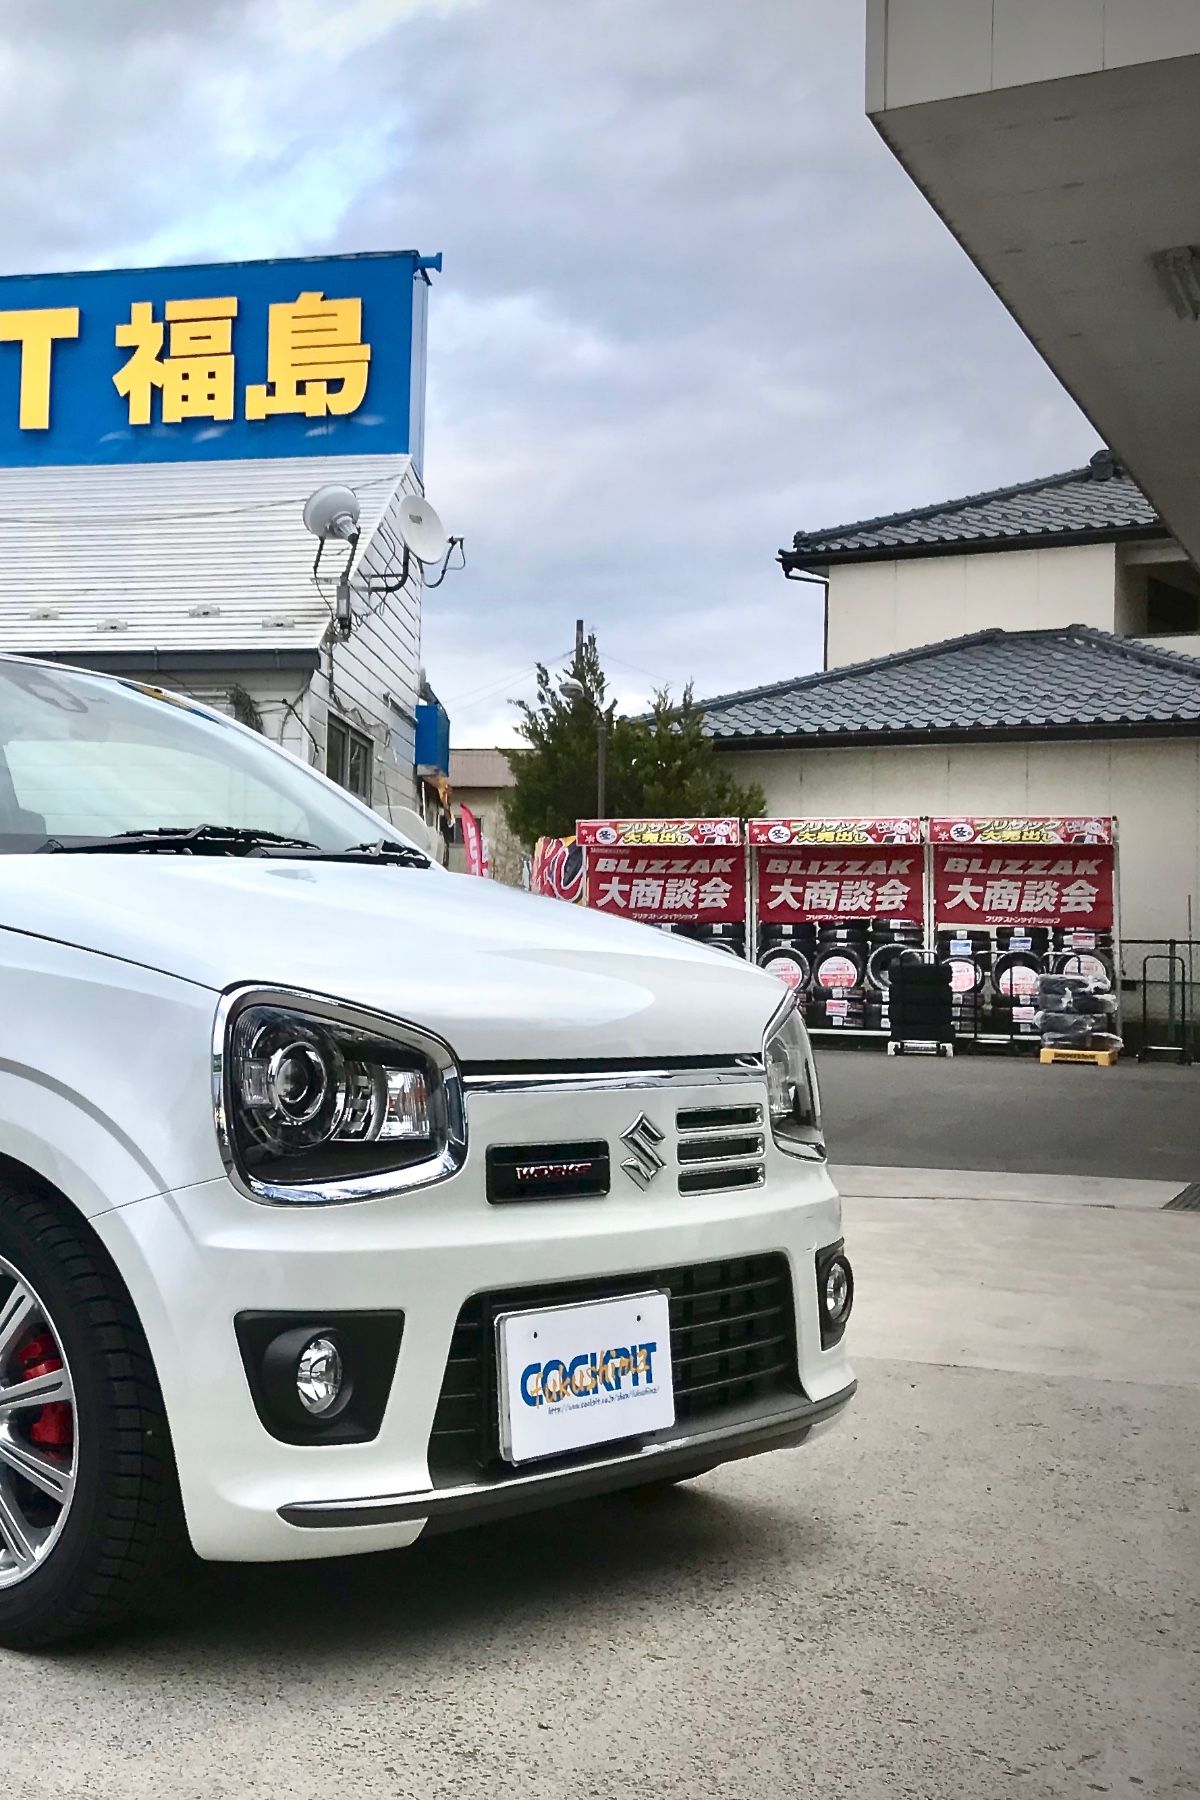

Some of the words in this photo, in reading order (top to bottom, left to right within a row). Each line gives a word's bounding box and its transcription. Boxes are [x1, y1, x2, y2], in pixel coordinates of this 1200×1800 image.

[112, 291, 372, 425] 福島
[595, 858, 737, 873] BLIZZAK
[765, 858, 914, 875] BLIZZAK
[943, 857, 1103, 875] BLIZZAK
[596, 876, 733, 909] 大商談会
[767, 878, 911, 911] 大商談会
[944, 877, 1099, 913] 大商談会
[520, 1342, 657, 1408] COCKPIT
